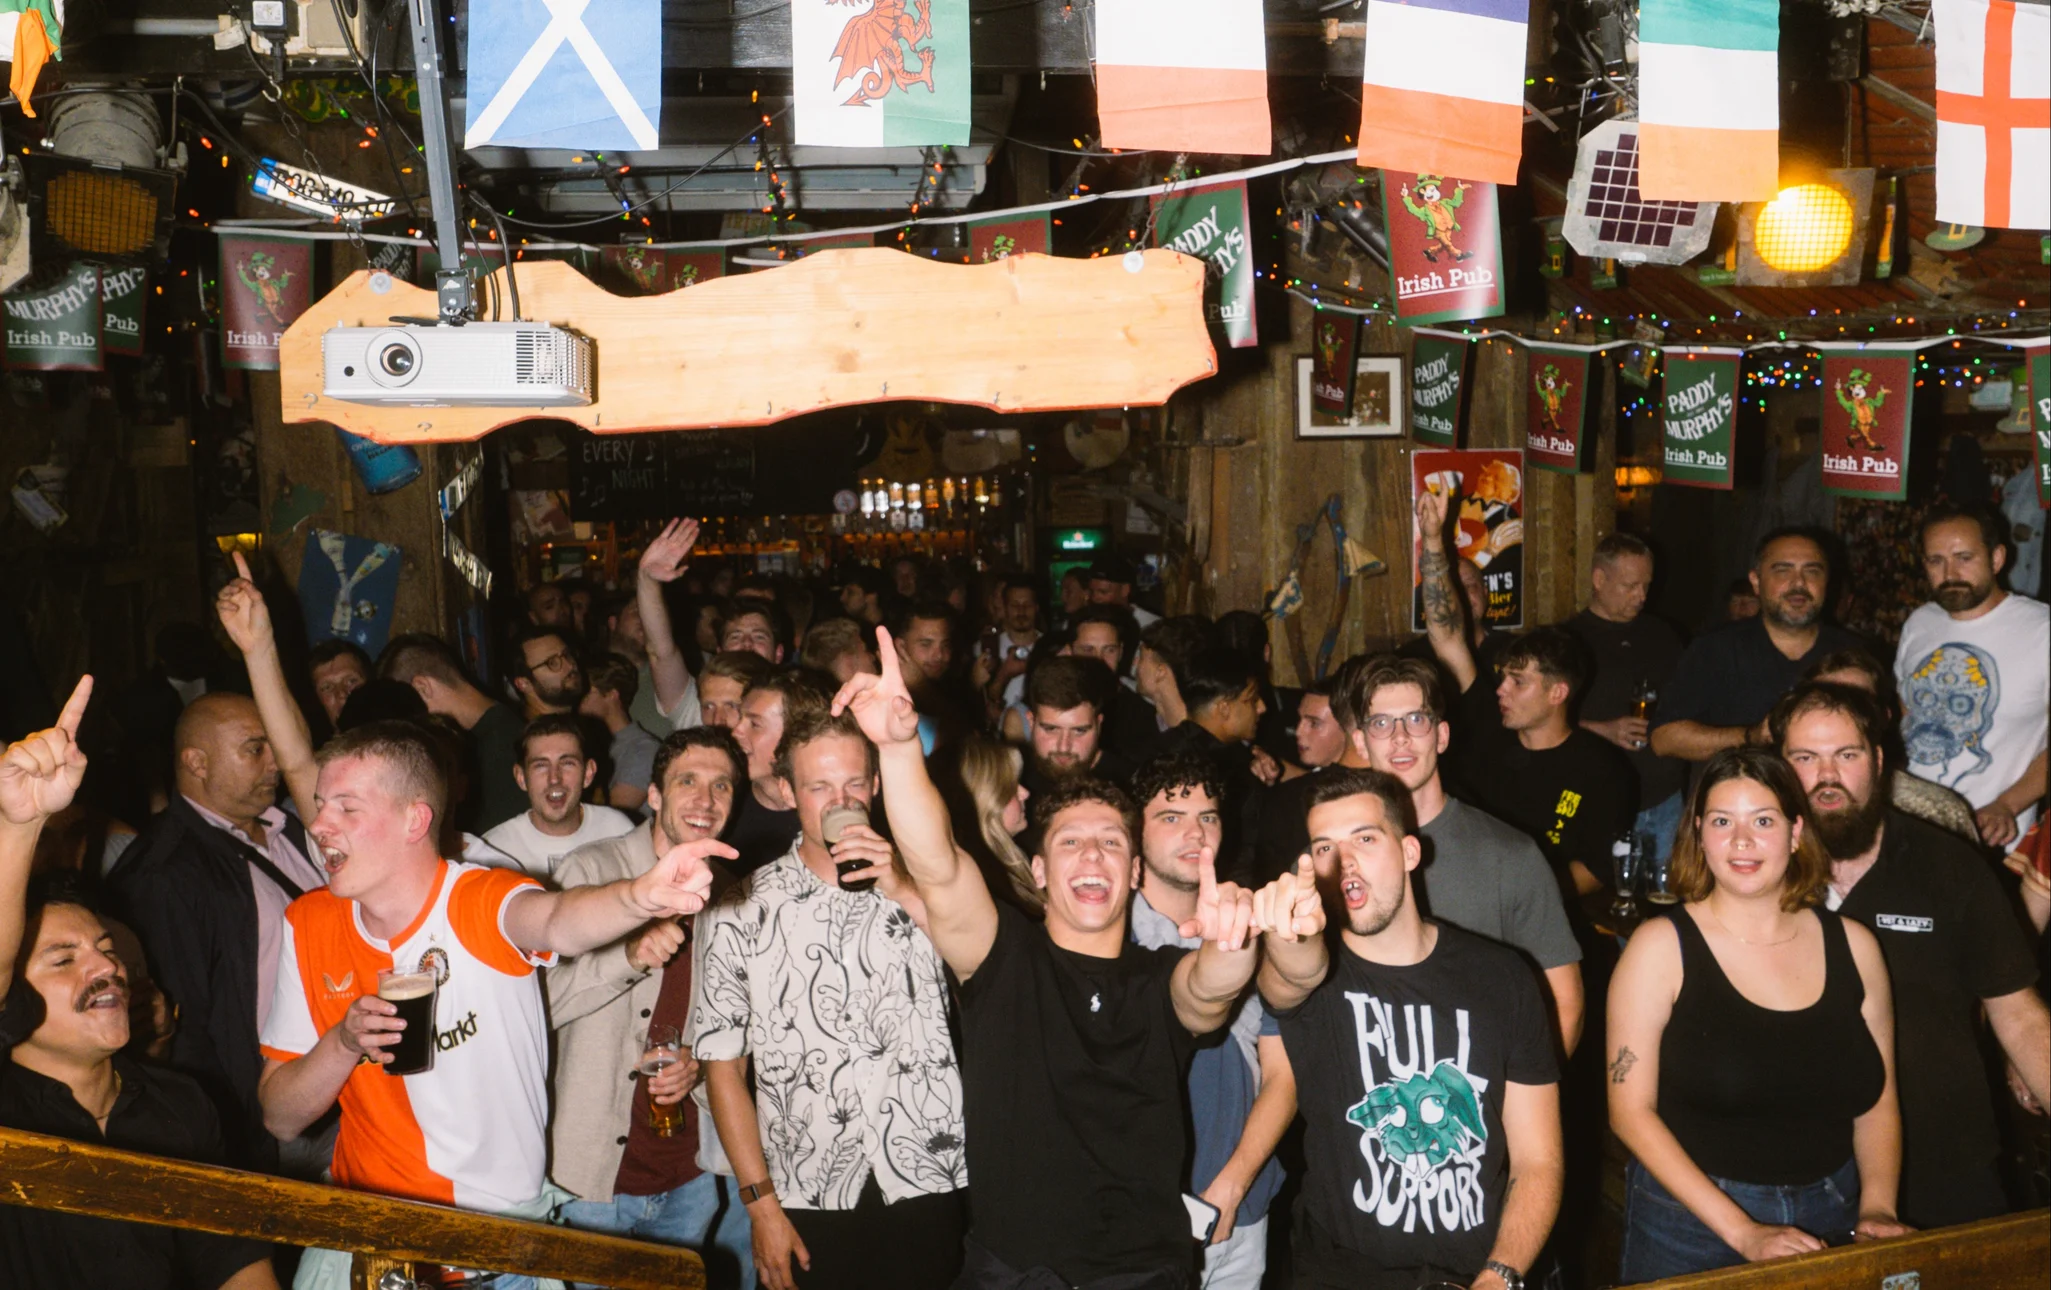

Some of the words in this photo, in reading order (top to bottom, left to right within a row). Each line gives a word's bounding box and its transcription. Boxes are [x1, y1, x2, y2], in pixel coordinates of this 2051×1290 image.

[1162, 205, 1222, 254] ADDY
[1397, 271, 1445, 295] Irish
[1449, 265, 1493, 288] Pub
[4, 270, 98, 321] MURPHY'S
[1207, 301, 1246, 320] Pub
[105, 313, 139, 332] Pub
[7, 329, 53, 345] Irish
[57, 331, 96, 347] Pub
[226, 329, 268, 345] Irish
[1414, 352, 1449, 384] PADDY
[1325, 384, 1345, 400] Pub
[1667, 371, 1717, 414] PADDY
[1431, 415, 1453, 431] Pub
[1664, 391, 1733, 441] MURPHY'S
[582, 440, 636, 469] EVERY
[1550, 436, 1575, 453] Pub
[1664, 447, 1694, 464] Irish
[1697, 449, 1727, 466] Pub
[1823, 453, 1858, 471] Irish
[1861, 456, 1899, 474] Pub
[611, 468, 656, 491] NIGHT
[1344, 990, 1489, 1095] FULL
[1353, 1131, 1487, 1235] SUPPORT
